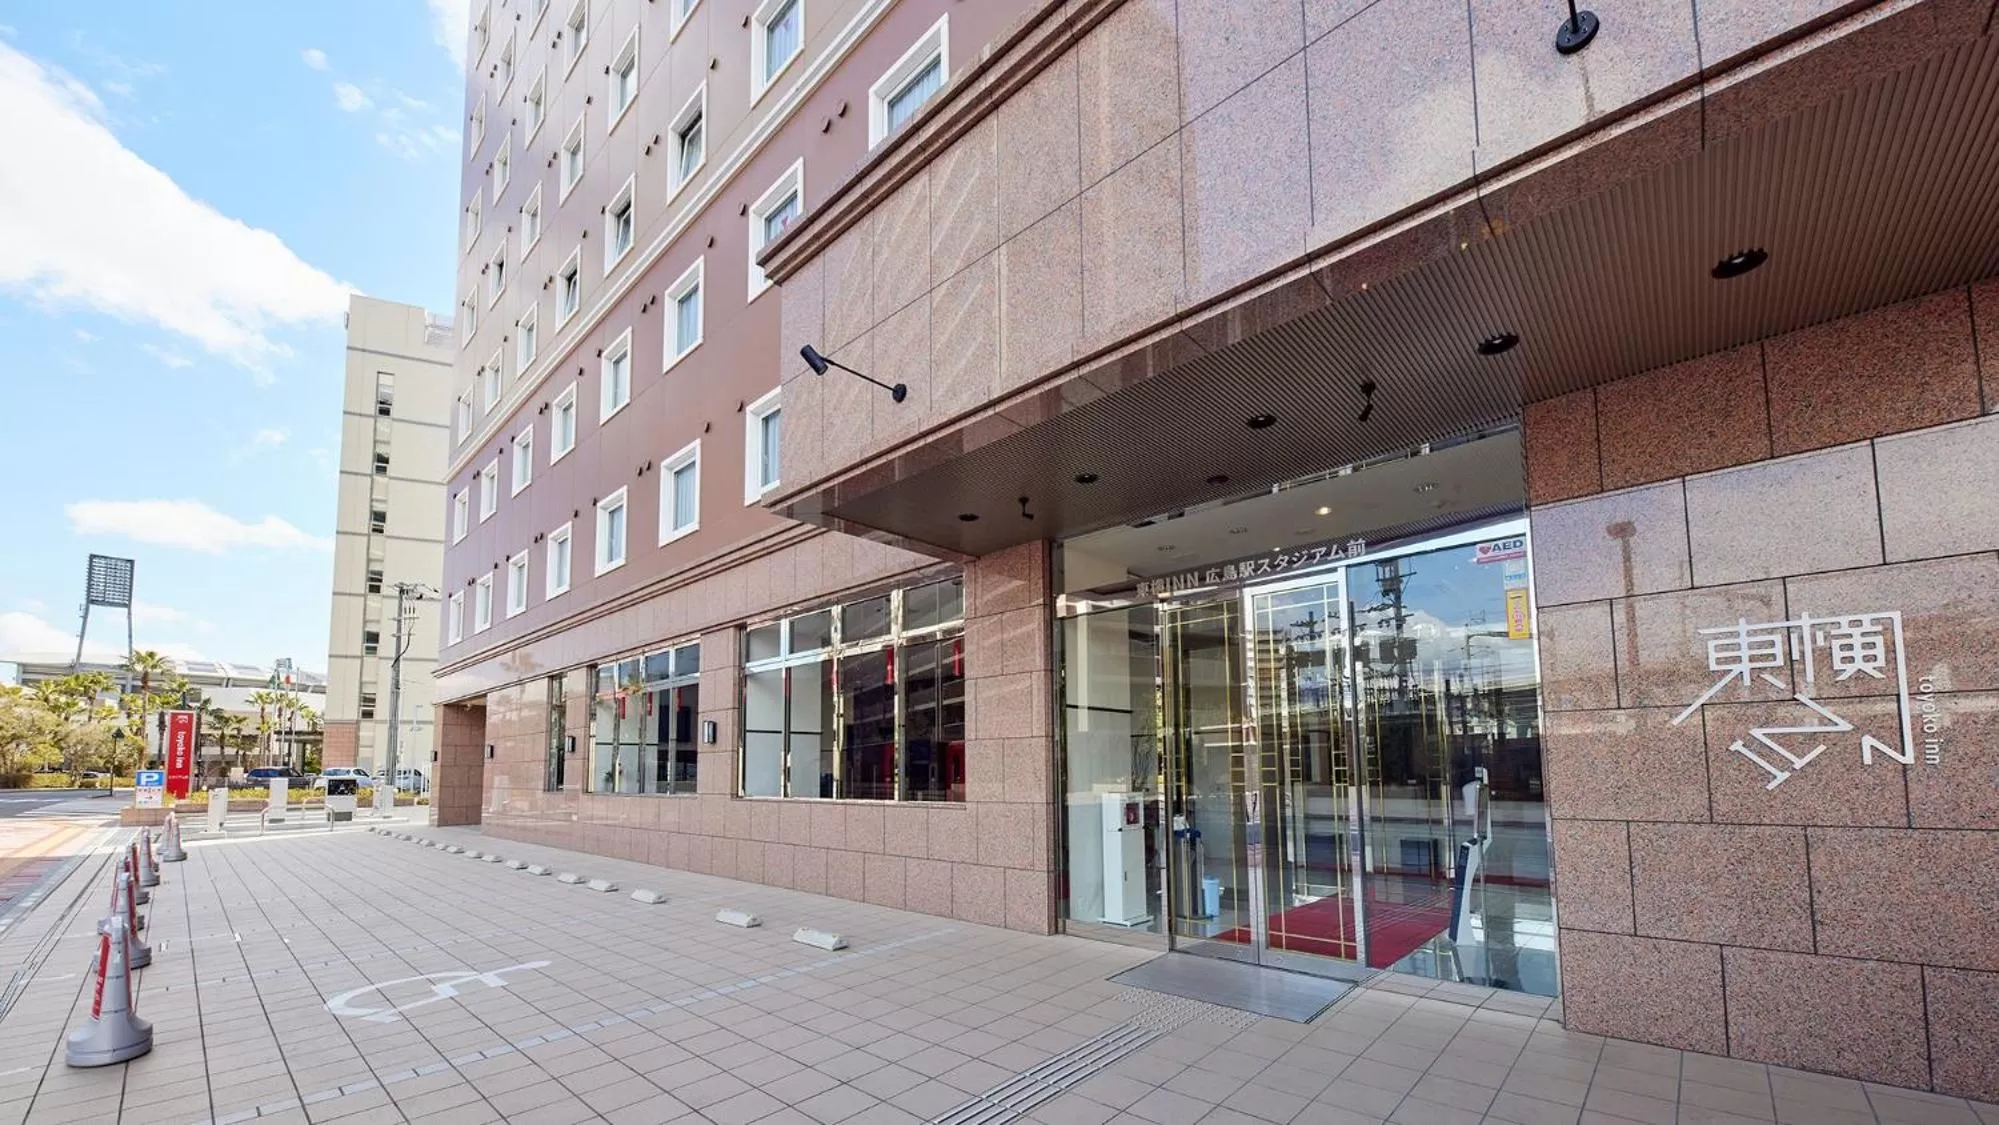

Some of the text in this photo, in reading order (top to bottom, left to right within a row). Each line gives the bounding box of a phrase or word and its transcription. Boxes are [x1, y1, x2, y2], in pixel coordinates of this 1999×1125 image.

[1492, 539, 1524, 552] AED
[1205, 538, 1367, 585] 広島駅スタジアム前
[1916, 674, 1944, 765] toyoko inn
[175, 731, 187, 757] toyoko
[140, 772, 159, 786] P
